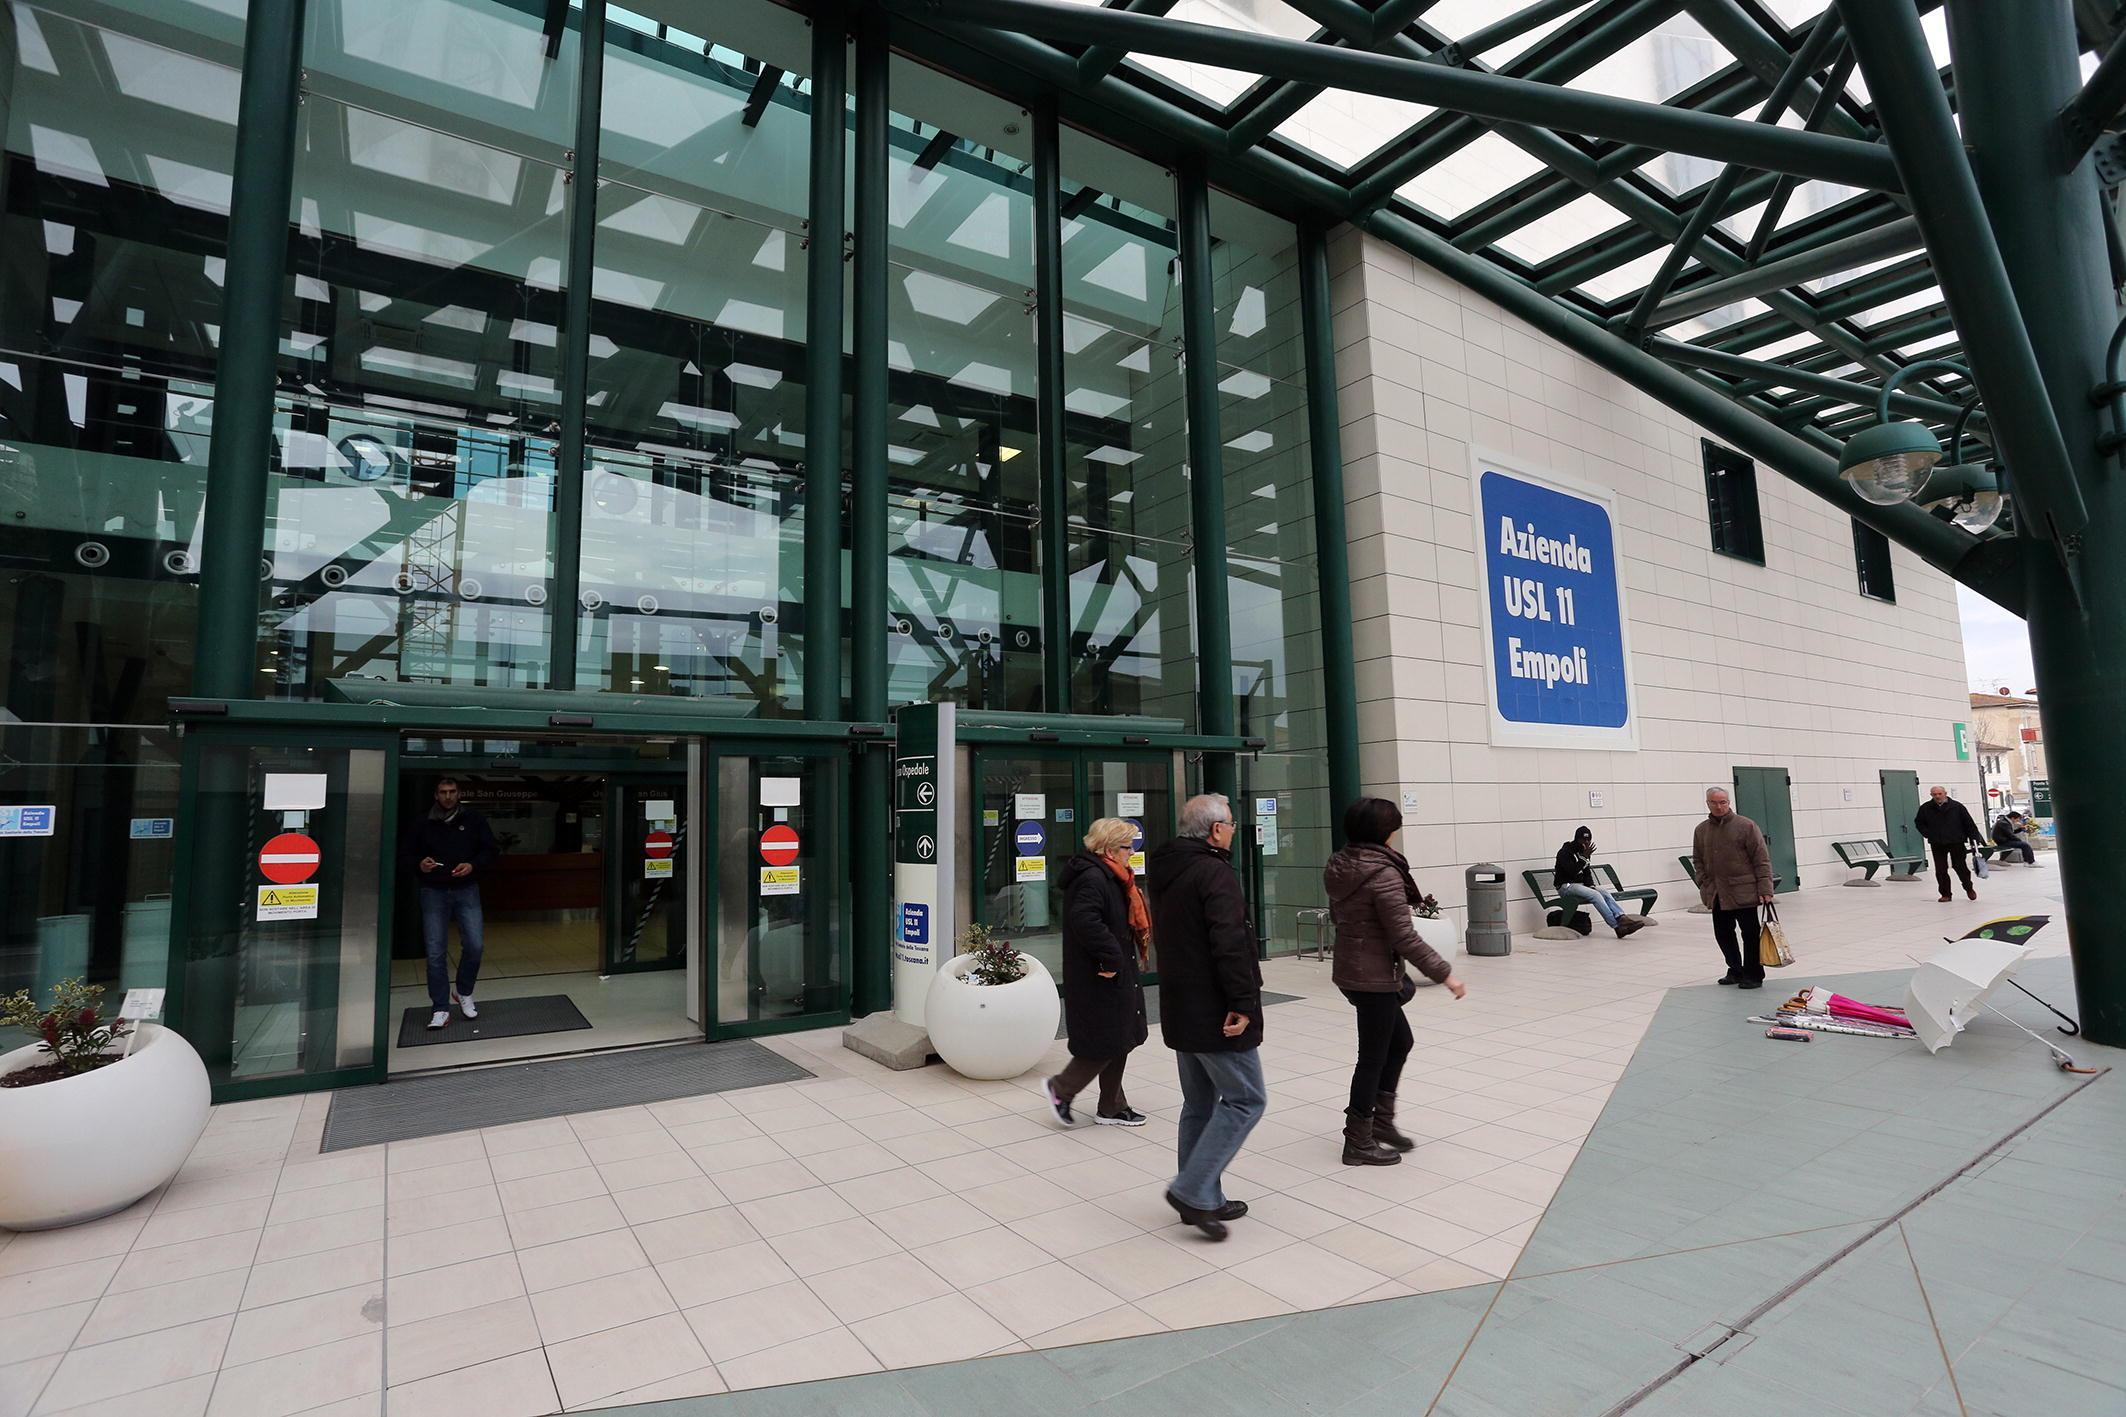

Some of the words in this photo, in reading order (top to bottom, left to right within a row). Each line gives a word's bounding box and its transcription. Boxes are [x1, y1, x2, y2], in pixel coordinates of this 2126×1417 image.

[1500, 515, 1592, 574] Azienda
[1503, 575, 1551, 622] USL
[1556, 586, 1576, 626] 11
[1508, 636, 1589, 690] Empoli
[901, 762, 930, 779] Ospedale
[905, 908, 924, 917] Azienda
[905, 927, 920, 937] Empoli
